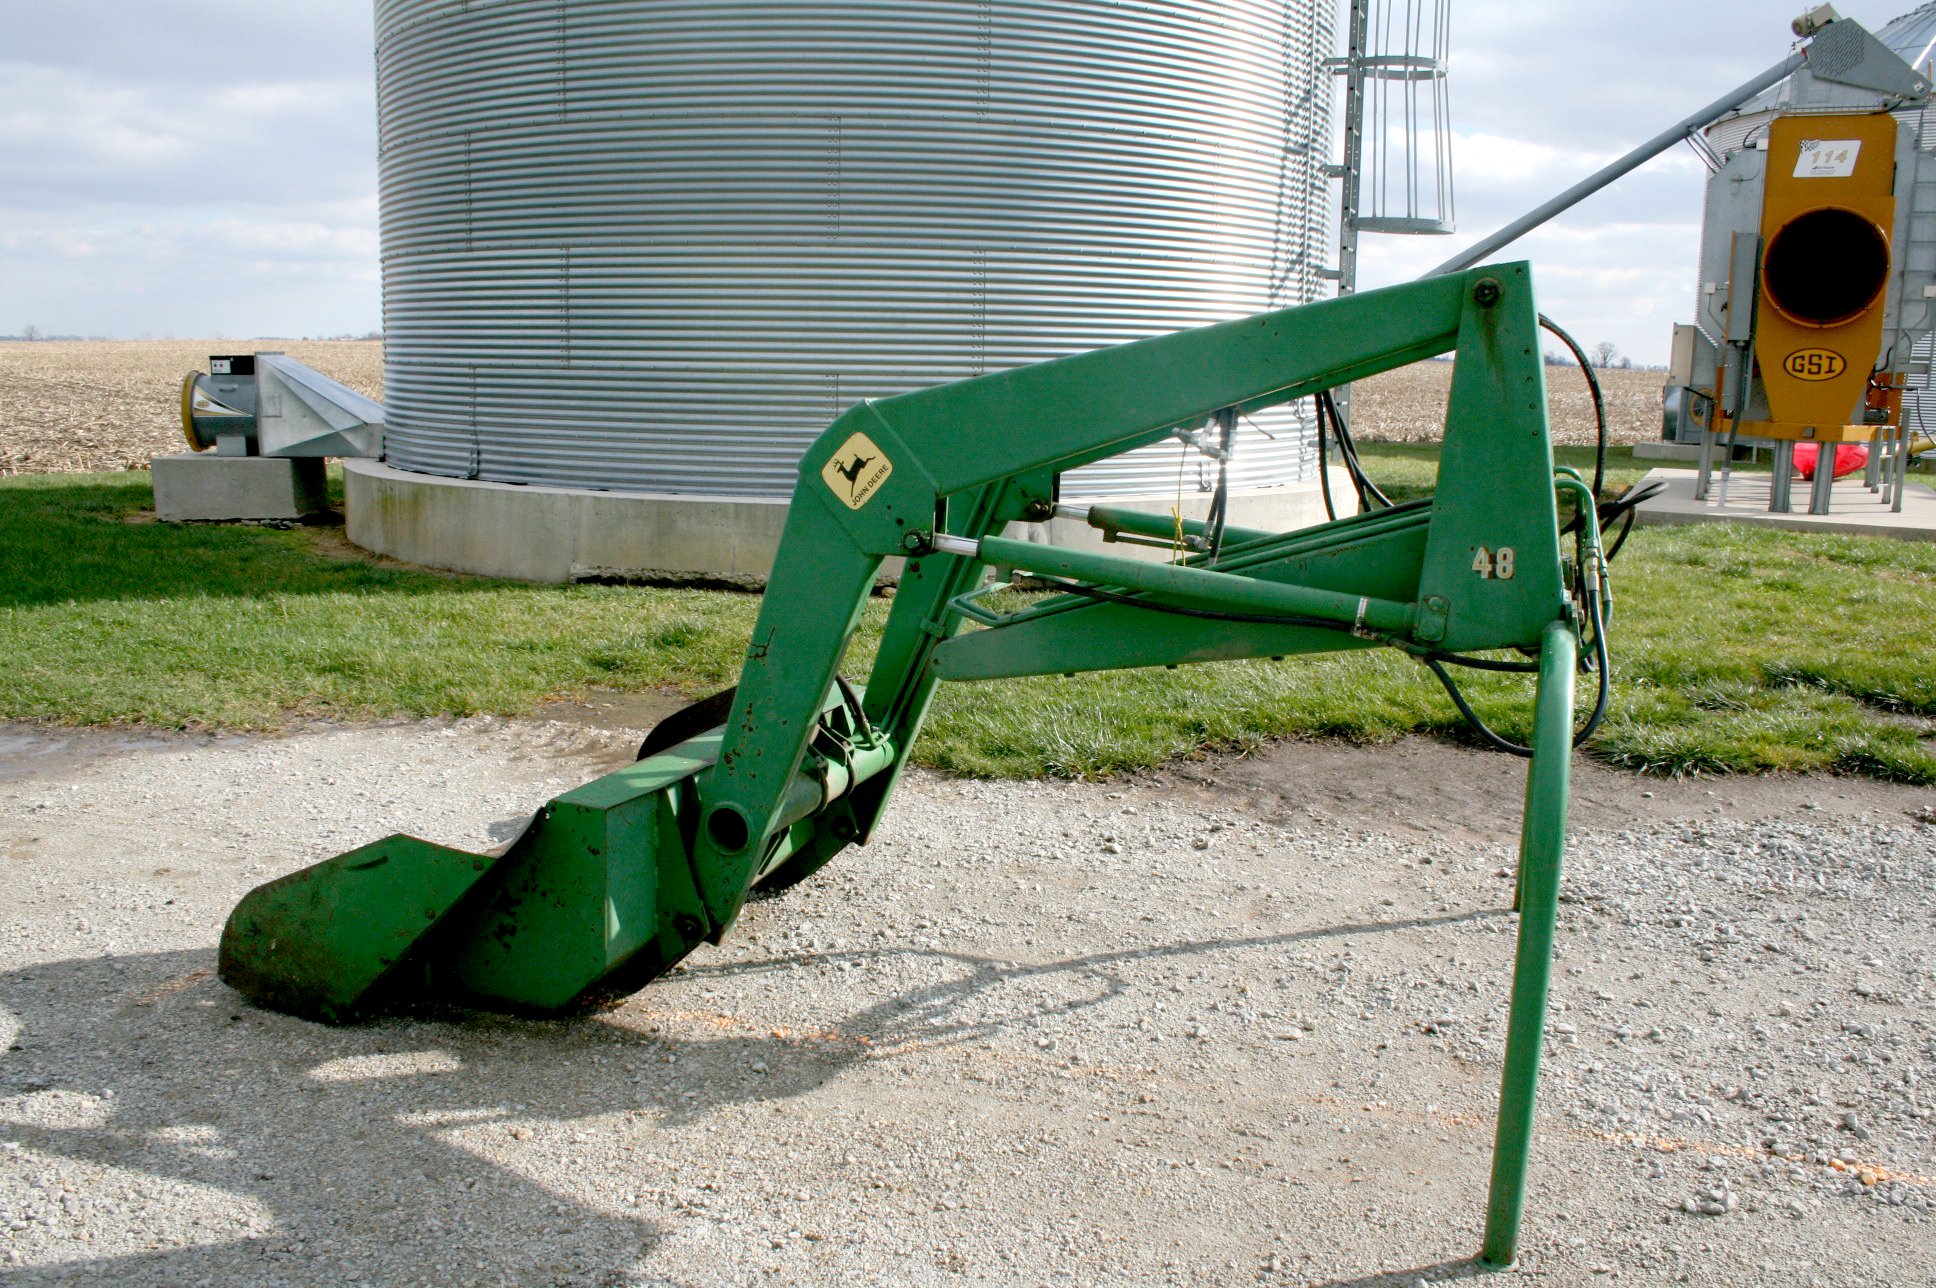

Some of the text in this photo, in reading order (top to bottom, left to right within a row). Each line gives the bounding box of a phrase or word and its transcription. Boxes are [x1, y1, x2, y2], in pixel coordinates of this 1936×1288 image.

[1812, 150, 1848, 164] 114
[1792, 354, 1836, 375] GSI
[852, 464, 889, 506] JOHN DEERE
[1472, 547, 1514, 579] 48
